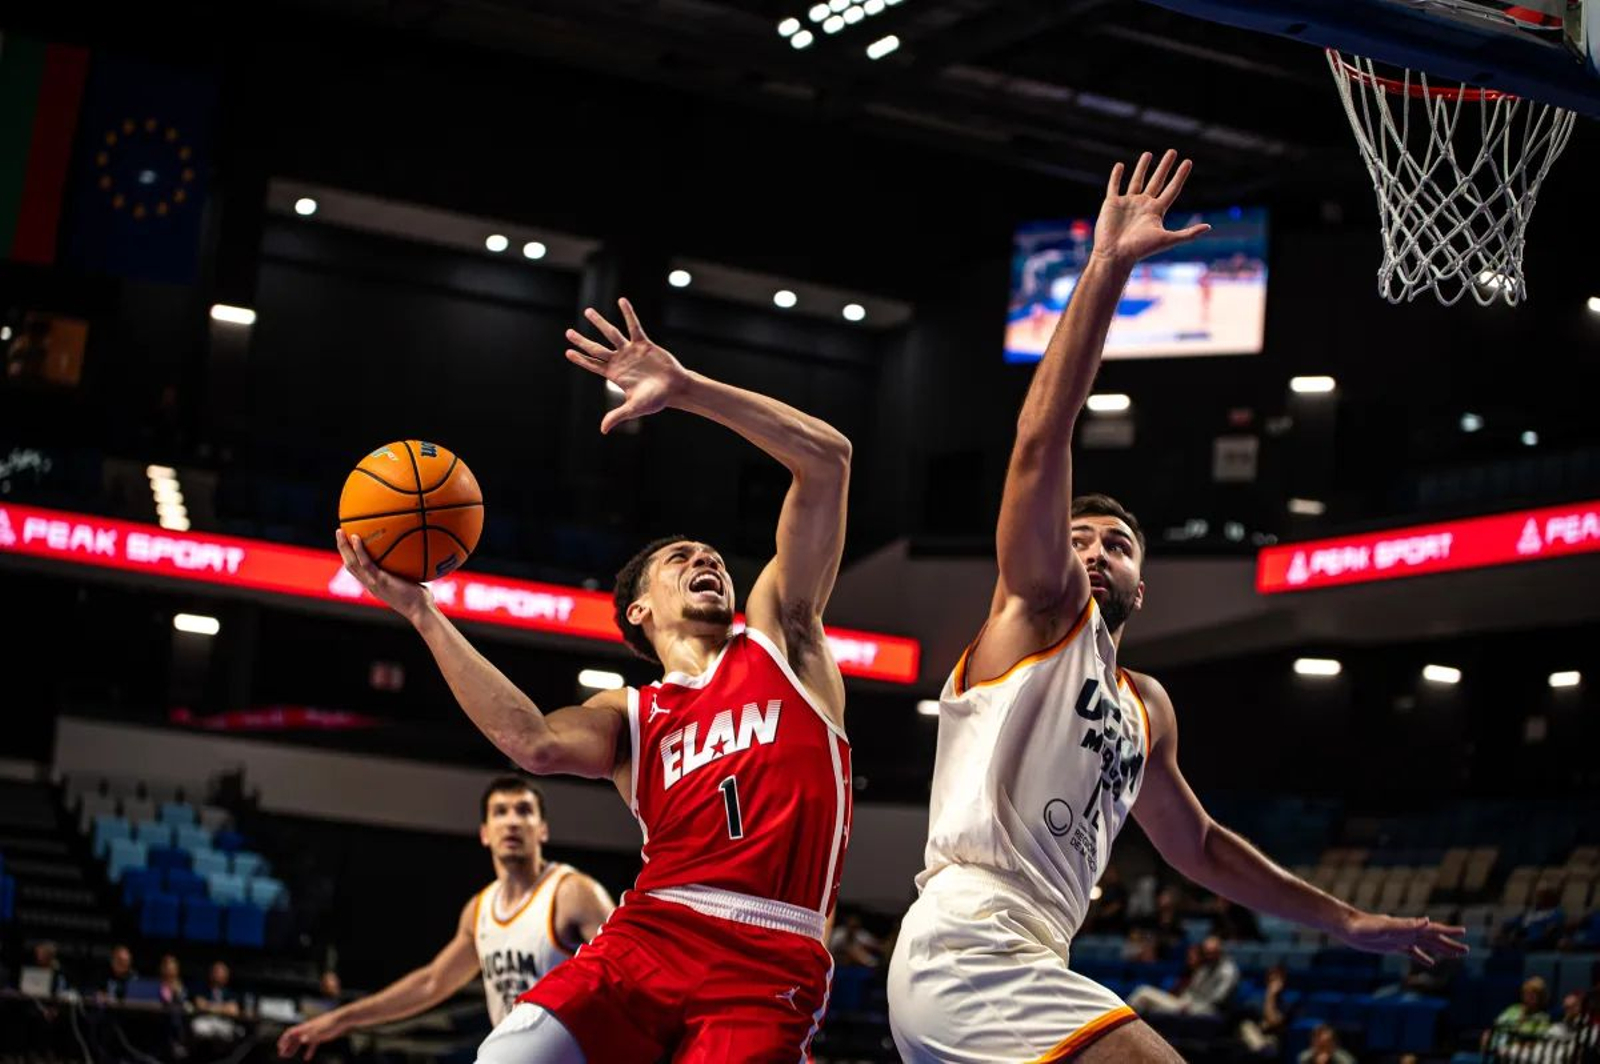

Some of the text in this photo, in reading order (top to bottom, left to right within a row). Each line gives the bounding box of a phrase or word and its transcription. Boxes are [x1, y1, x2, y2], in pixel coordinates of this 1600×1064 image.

[23, 516, 244, 574] PEAK SPORT
[1373, 532, 1453, 569] SPORT
[464, 581, 574, 622] SPORT
[660, 699, 782, 791] ELAN
[718, 774, 743, 840] 1
